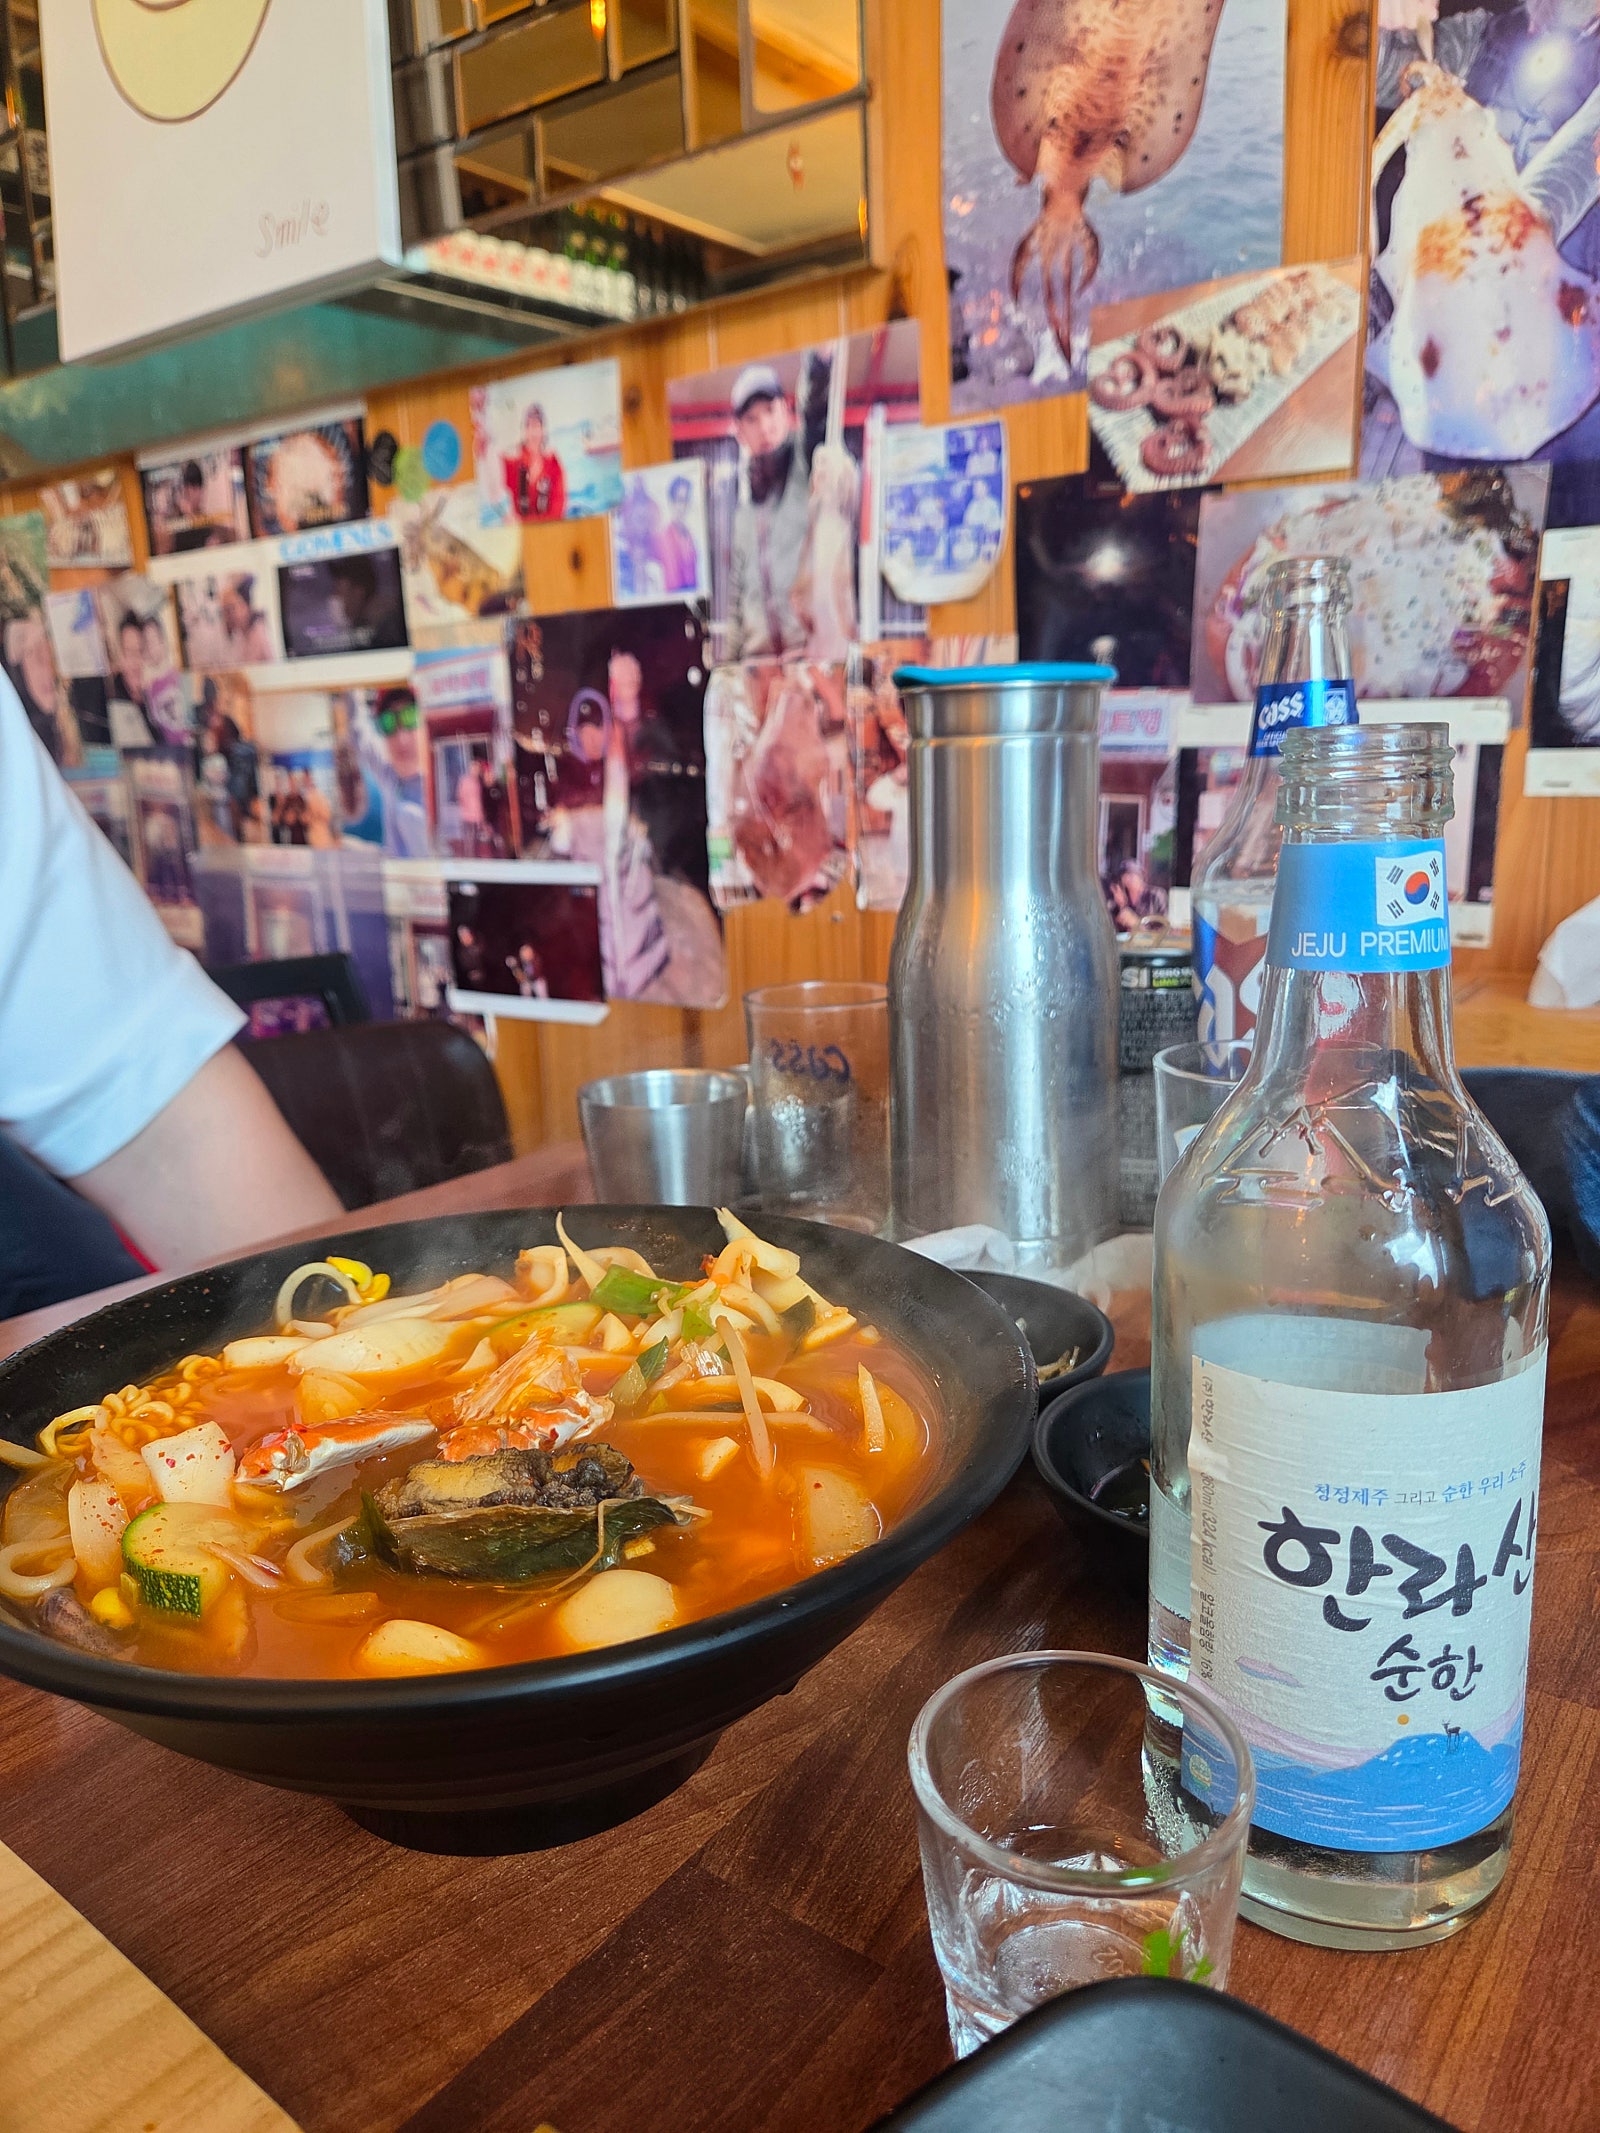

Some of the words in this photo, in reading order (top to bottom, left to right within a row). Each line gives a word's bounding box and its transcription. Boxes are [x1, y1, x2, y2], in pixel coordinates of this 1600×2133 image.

[1291, 932, 1346, 958] JEJU
[1360, 927, 1449, 957] PREMIUM
[1314, 1483, 1389, 1507] 청정제주
[1394, 1491, 1436, 1505] 그리고
[1441, 1480, 1474, 1503] 순한
[1478, 1471, 1504, 1495] 우리
[1508, 1461, 1528, 1482] 소주
[1257, 1491, 1536, 1632] 한라산
[1200, 1591, 1215, 1653] 알코올함량
[1369, 1633, 1484, 1702] 순한
